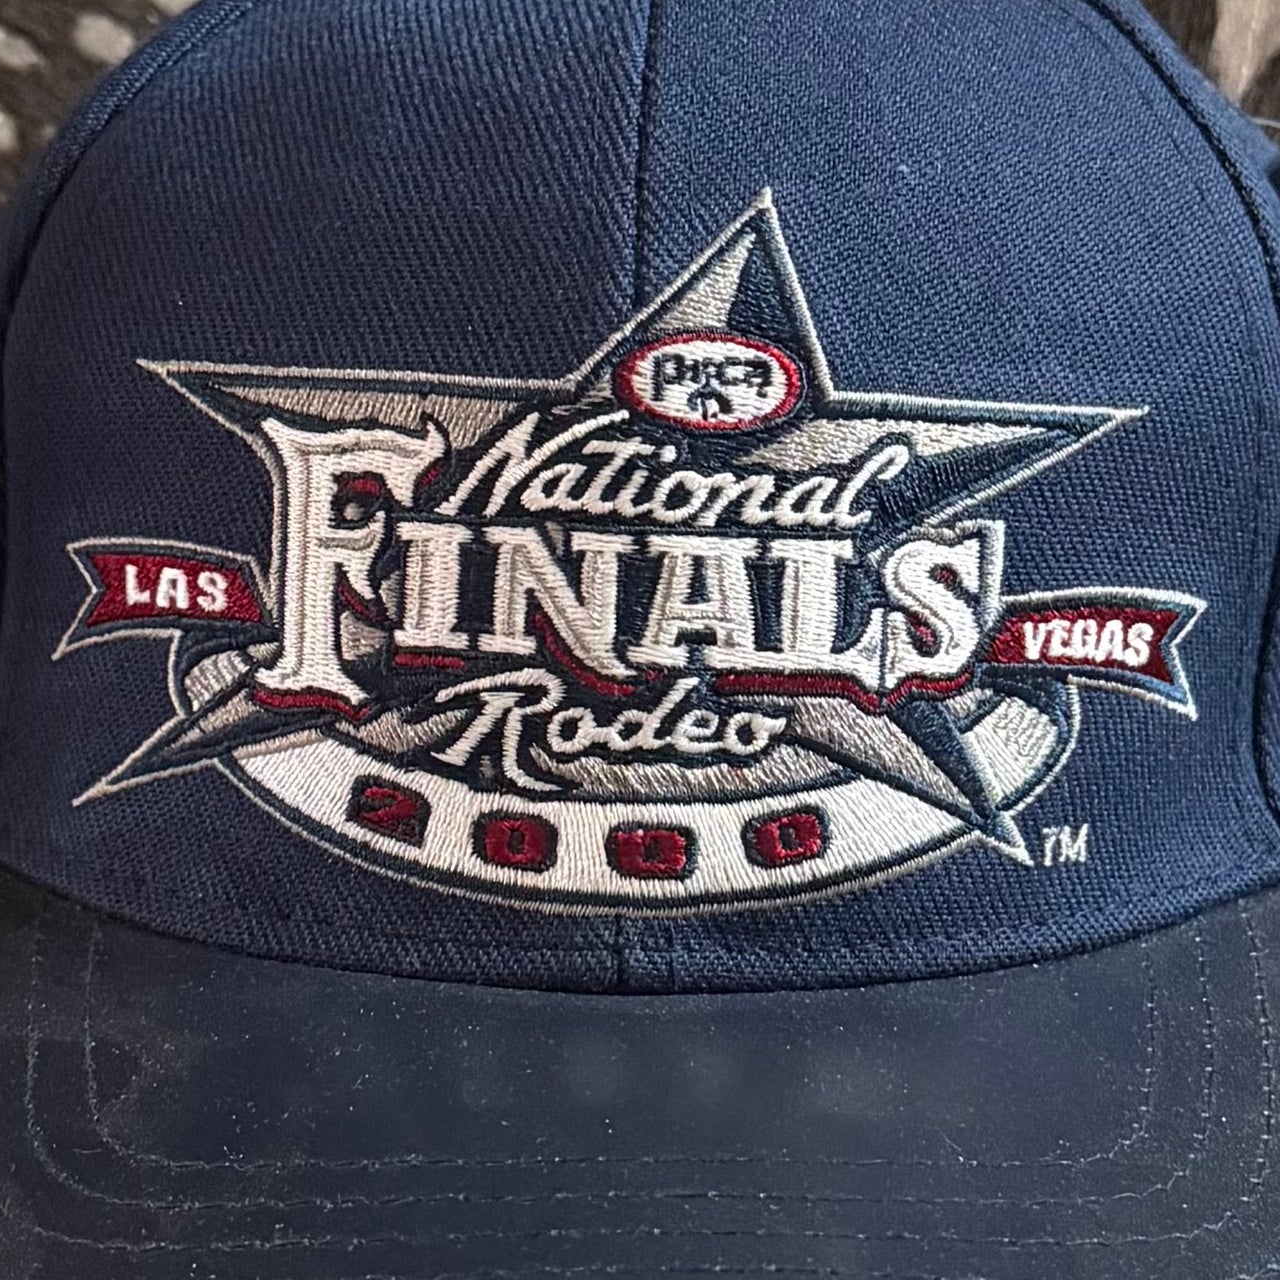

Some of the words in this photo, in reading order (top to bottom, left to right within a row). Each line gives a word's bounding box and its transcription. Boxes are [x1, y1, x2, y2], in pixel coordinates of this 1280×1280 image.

[432, 409, 912, 528] National
[124, 564, 228, 612] LAS
[255, 417, 982, 706] FINALS
[1022, 618, 1154, 666] VEGAS
[430, 666, 787, 791] Rodeo
[347, 774, 828, 880] 2000
[1042, 822, 1088, 867] TM
